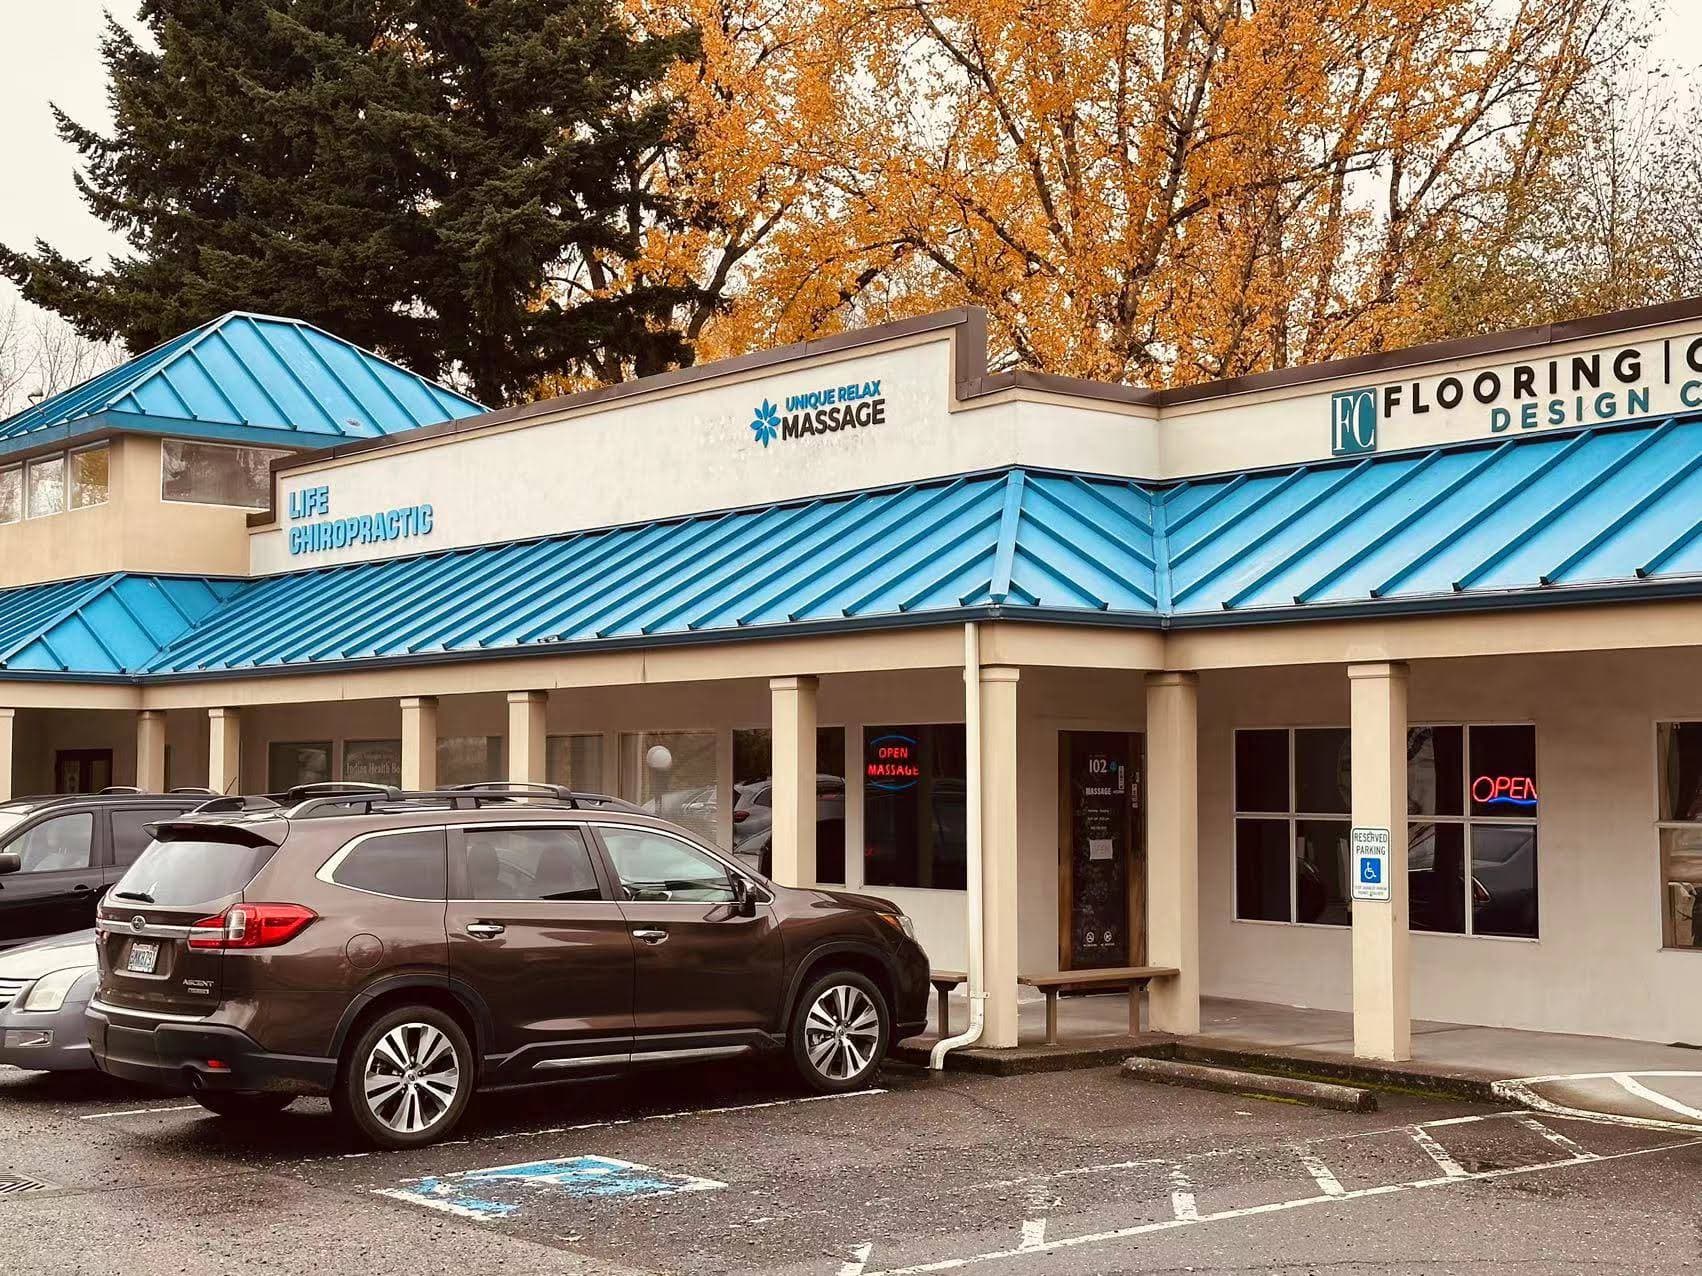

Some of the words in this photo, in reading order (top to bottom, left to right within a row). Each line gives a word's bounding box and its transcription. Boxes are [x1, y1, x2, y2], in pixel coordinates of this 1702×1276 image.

[785, 387, 836, 412] UNIQUE
[837, 379, 882, 403] RELAX
[1383, 348, 1643, 418] FLOORING
[781, 398, 886, 441] MASSAGE
[1332, 391, 1377, 451] FC
[1490, 386, 1650, 433] DESIGN
[288, 485, 330, 520] LIFE
[288, 503, 434, 556] CHIROPRACTIC
[878, 747, 909, 759] OPEN
[1089, 759, 1107, 773] 102
[867, 763, 920, 777] MASSAGE
[1085, 787, 1112, 796] MASSAGE
[1472, 775, 1538, 802] OPEN
[1354, 832, 1388, 843] RESERVED
[1356, 845, 1386, 855] PARKING
[182, 978, 215, 988] ASCENT
